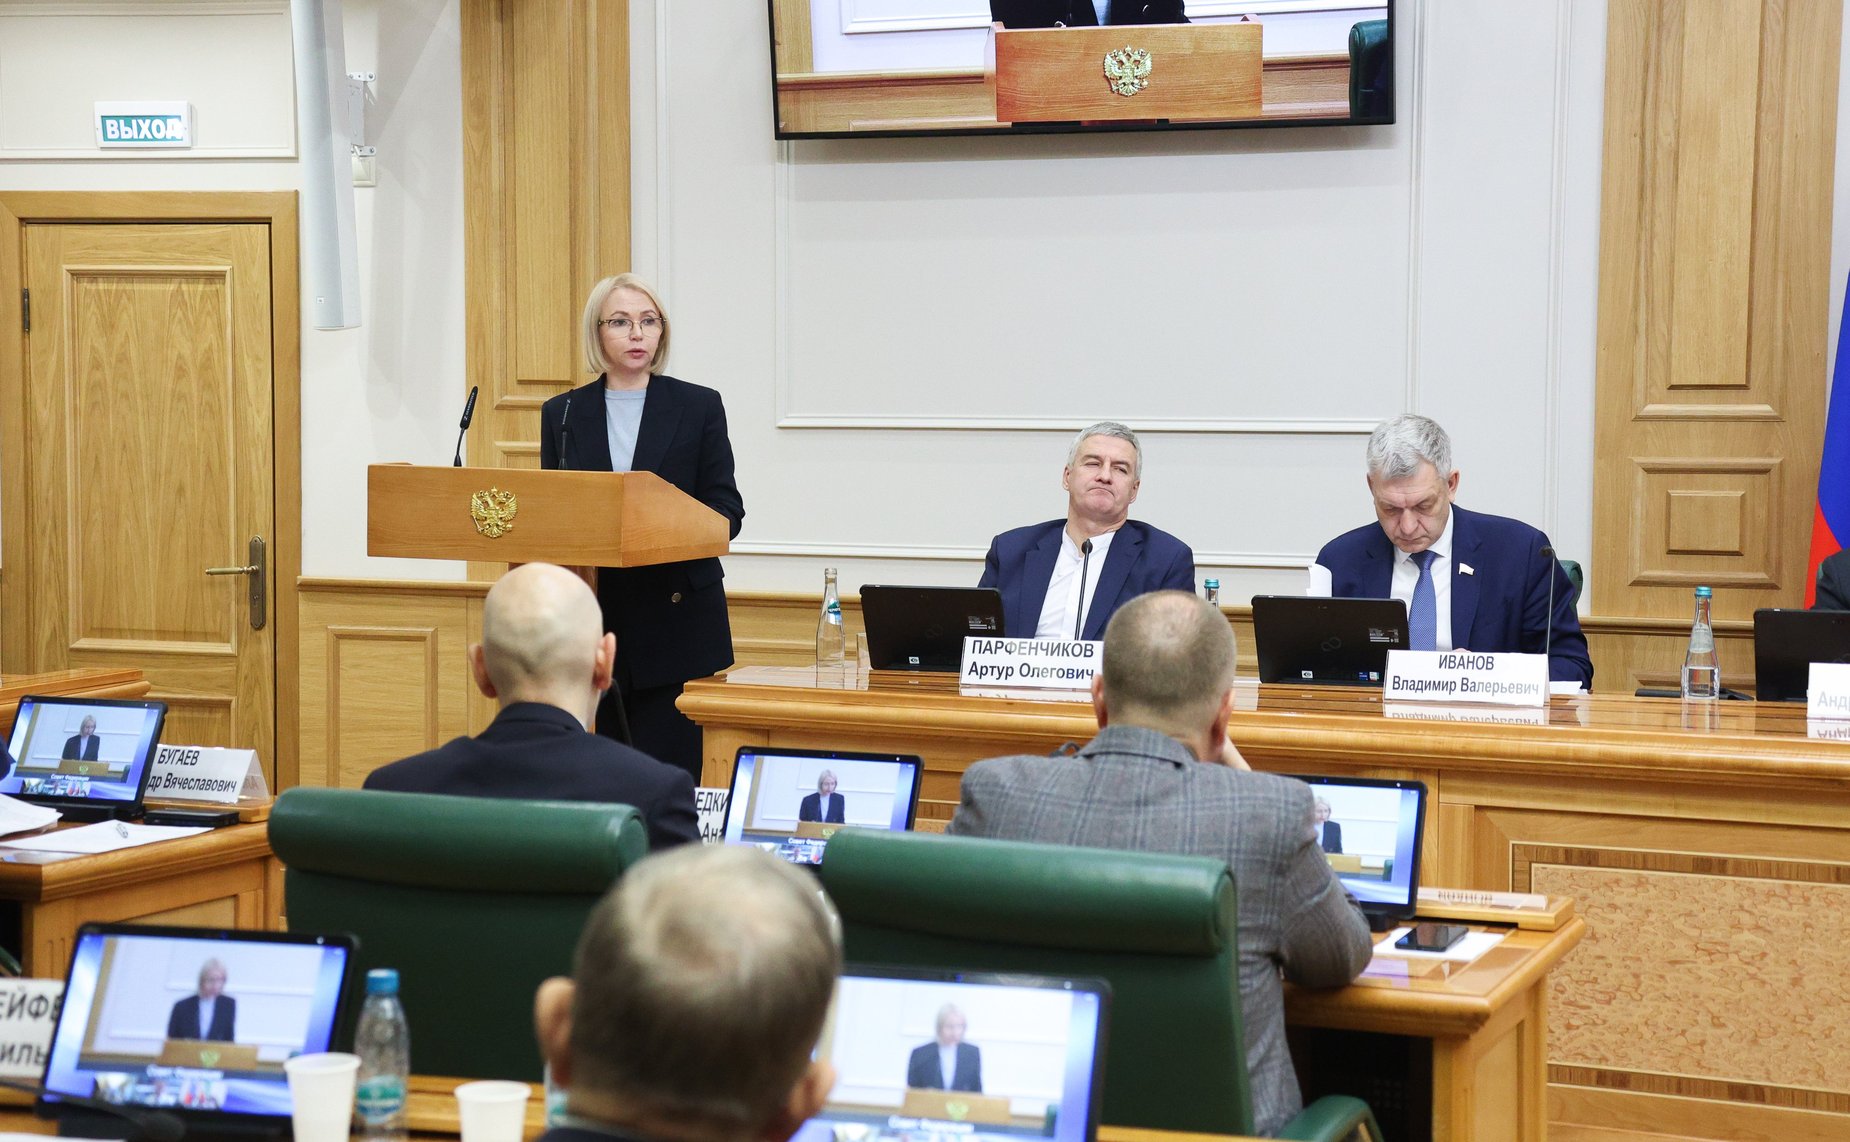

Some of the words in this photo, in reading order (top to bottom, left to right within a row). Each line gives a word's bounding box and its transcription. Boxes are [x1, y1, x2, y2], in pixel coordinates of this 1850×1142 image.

[105, 118, 184, 139] ВЫХОД
[971, 639, 1094, 658] ПАРФЕНЧИКОВ
[968, 661, 1014, 681] Артур
[1019, 662, 1094, 680] Олегович
[1438, 654, 1495, 671] ИВАНОВ
[1392, 675, 1457, 695] Владимир
[1460, 677, 1539, 697] Валерьевич
[1817, 691, 1850, 712] Анд
[157, 748, 200, 766] БУГАЕВ
[163, 772, 237, 793] Вячеславович
